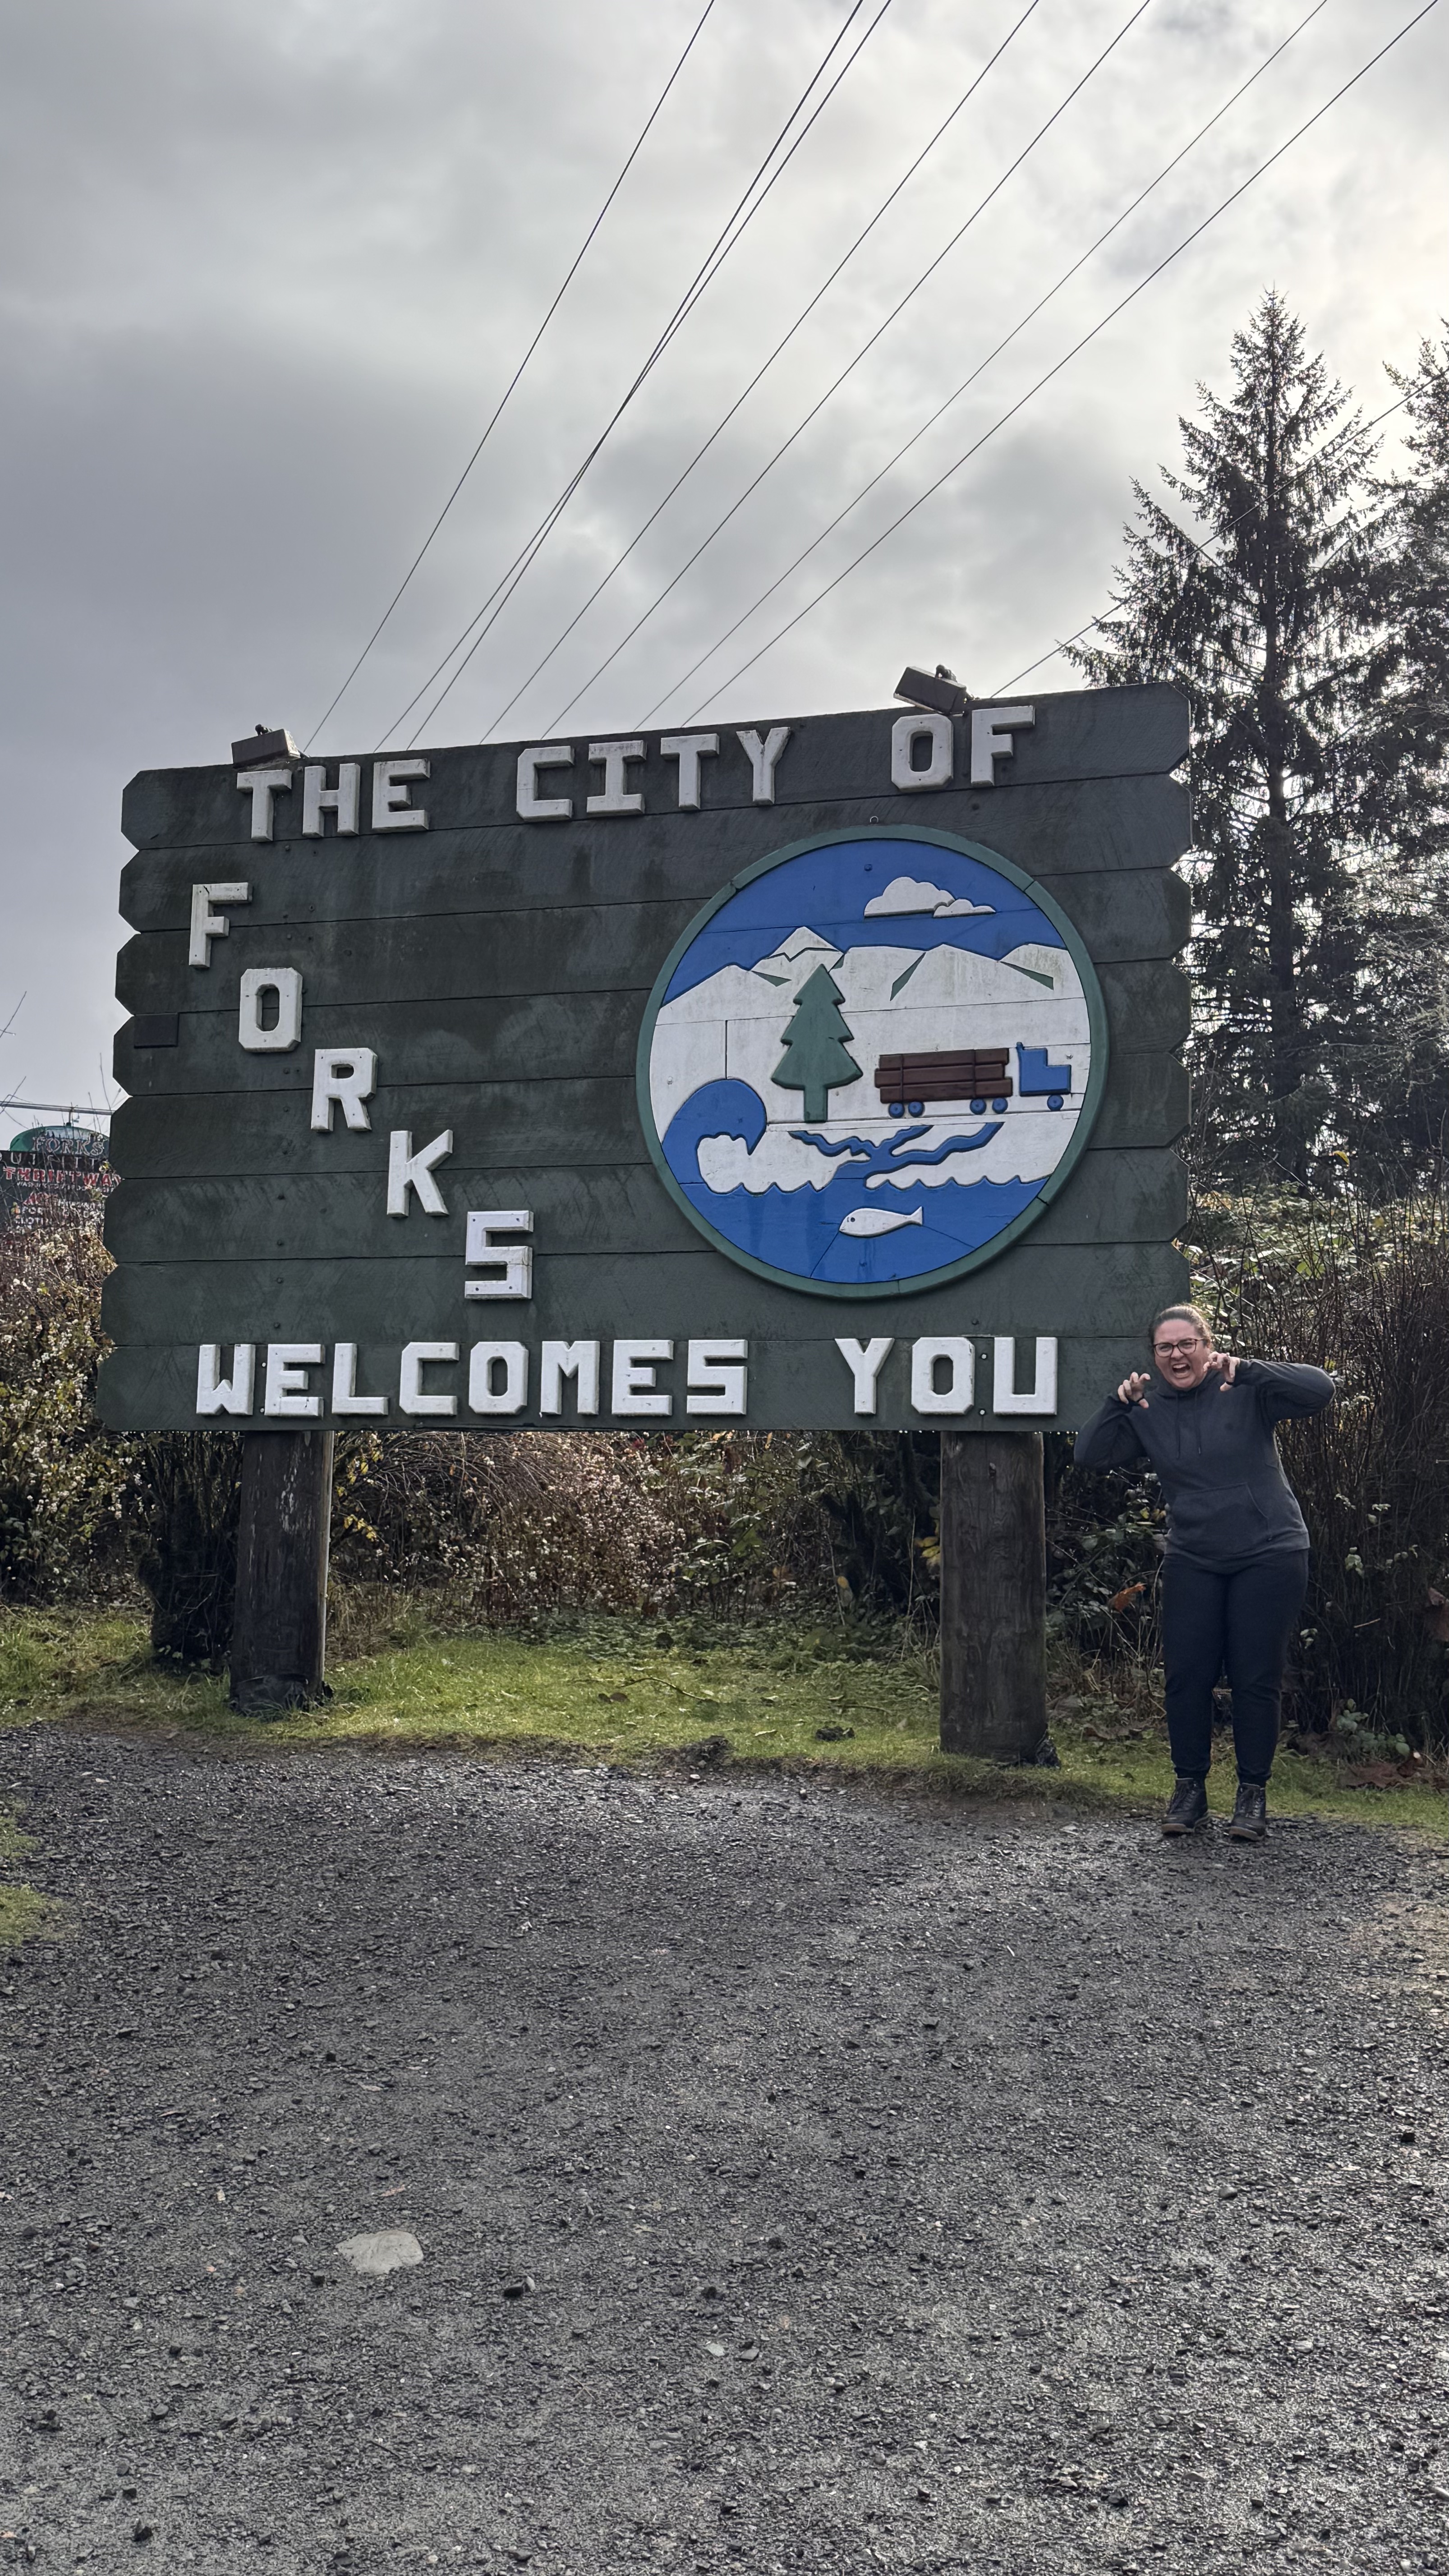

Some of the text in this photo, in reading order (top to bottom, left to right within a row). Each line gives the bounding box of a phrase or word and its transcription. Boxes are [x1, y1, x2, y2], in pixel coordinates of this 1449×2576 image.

[237, 705, 1035, 842] THE CITY OF
[189, 882, 534, 1300] FORKS
[32, 1136, 106, 1156] FORKS
[196, 1337, 1058, 1417] WELCOMES YOU
